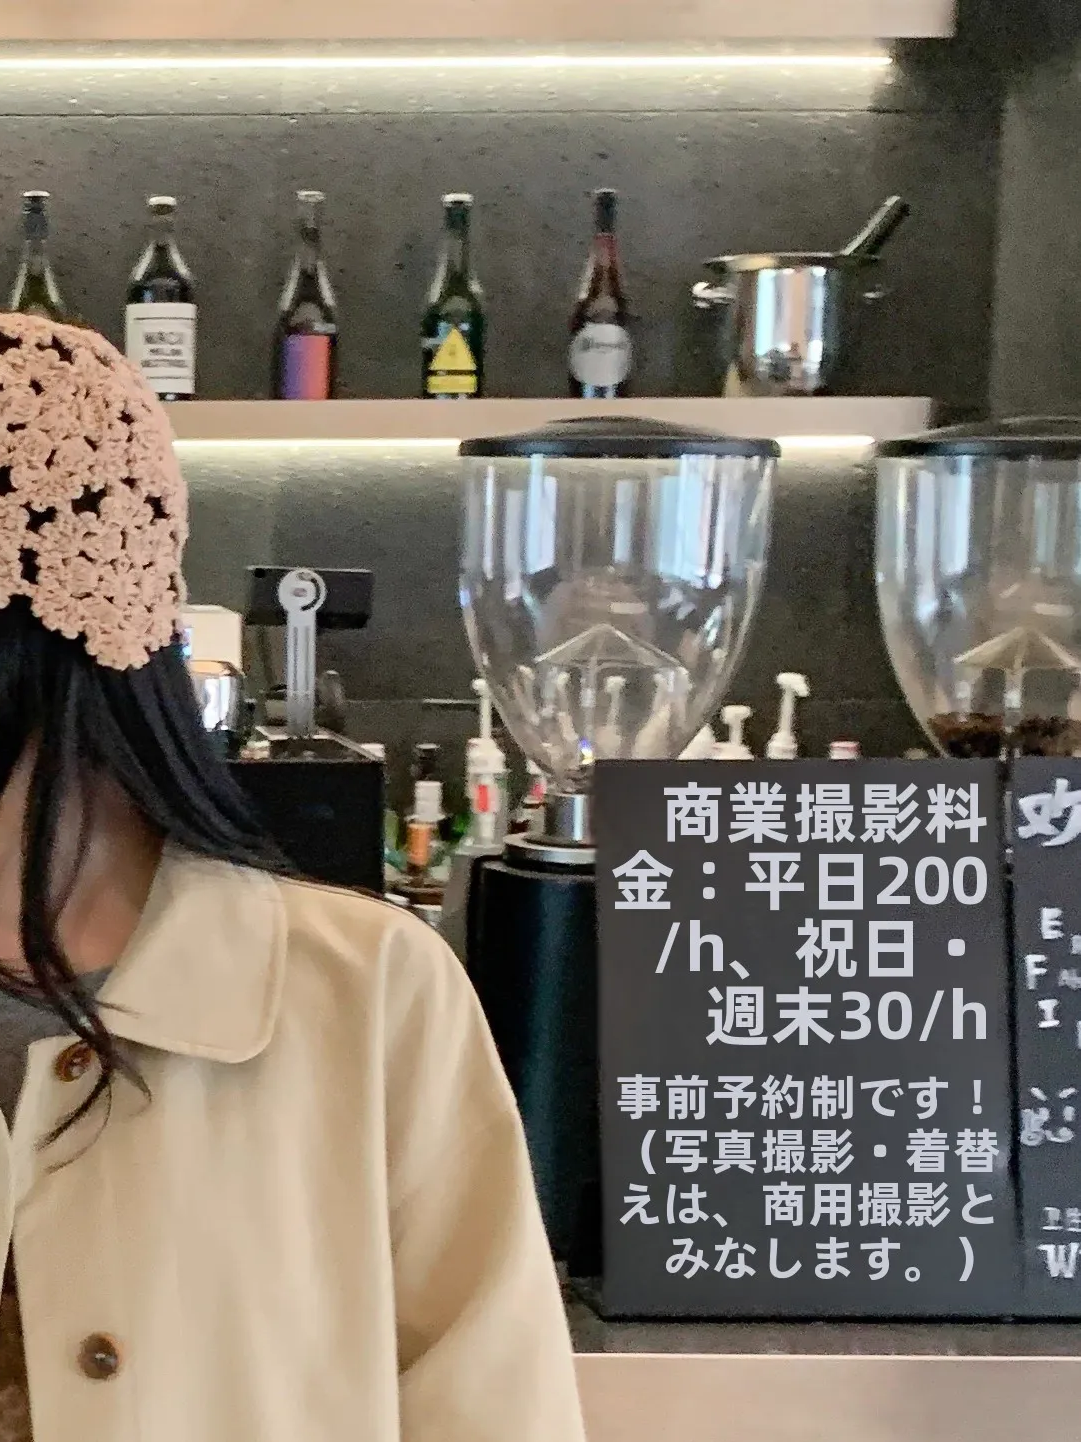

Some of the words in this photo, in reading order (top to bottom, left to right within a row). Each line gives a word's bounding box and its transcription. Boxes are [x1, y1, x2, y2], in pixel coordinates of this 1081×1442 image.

[663, 781, 988, 845] 商業撮影料
[611, 849, 988, 911] 金：平日200
[705, 985, 988, 1046] 週末30/h
[616, 1073, 983, 1120] 事前予約制です！
[640, 1127, 1000, 1175] （写真撮影・着替
[619, 1181, 995, 1228] えは、商用撮影と
[665, 1236, 975, 1283] みなします。）
